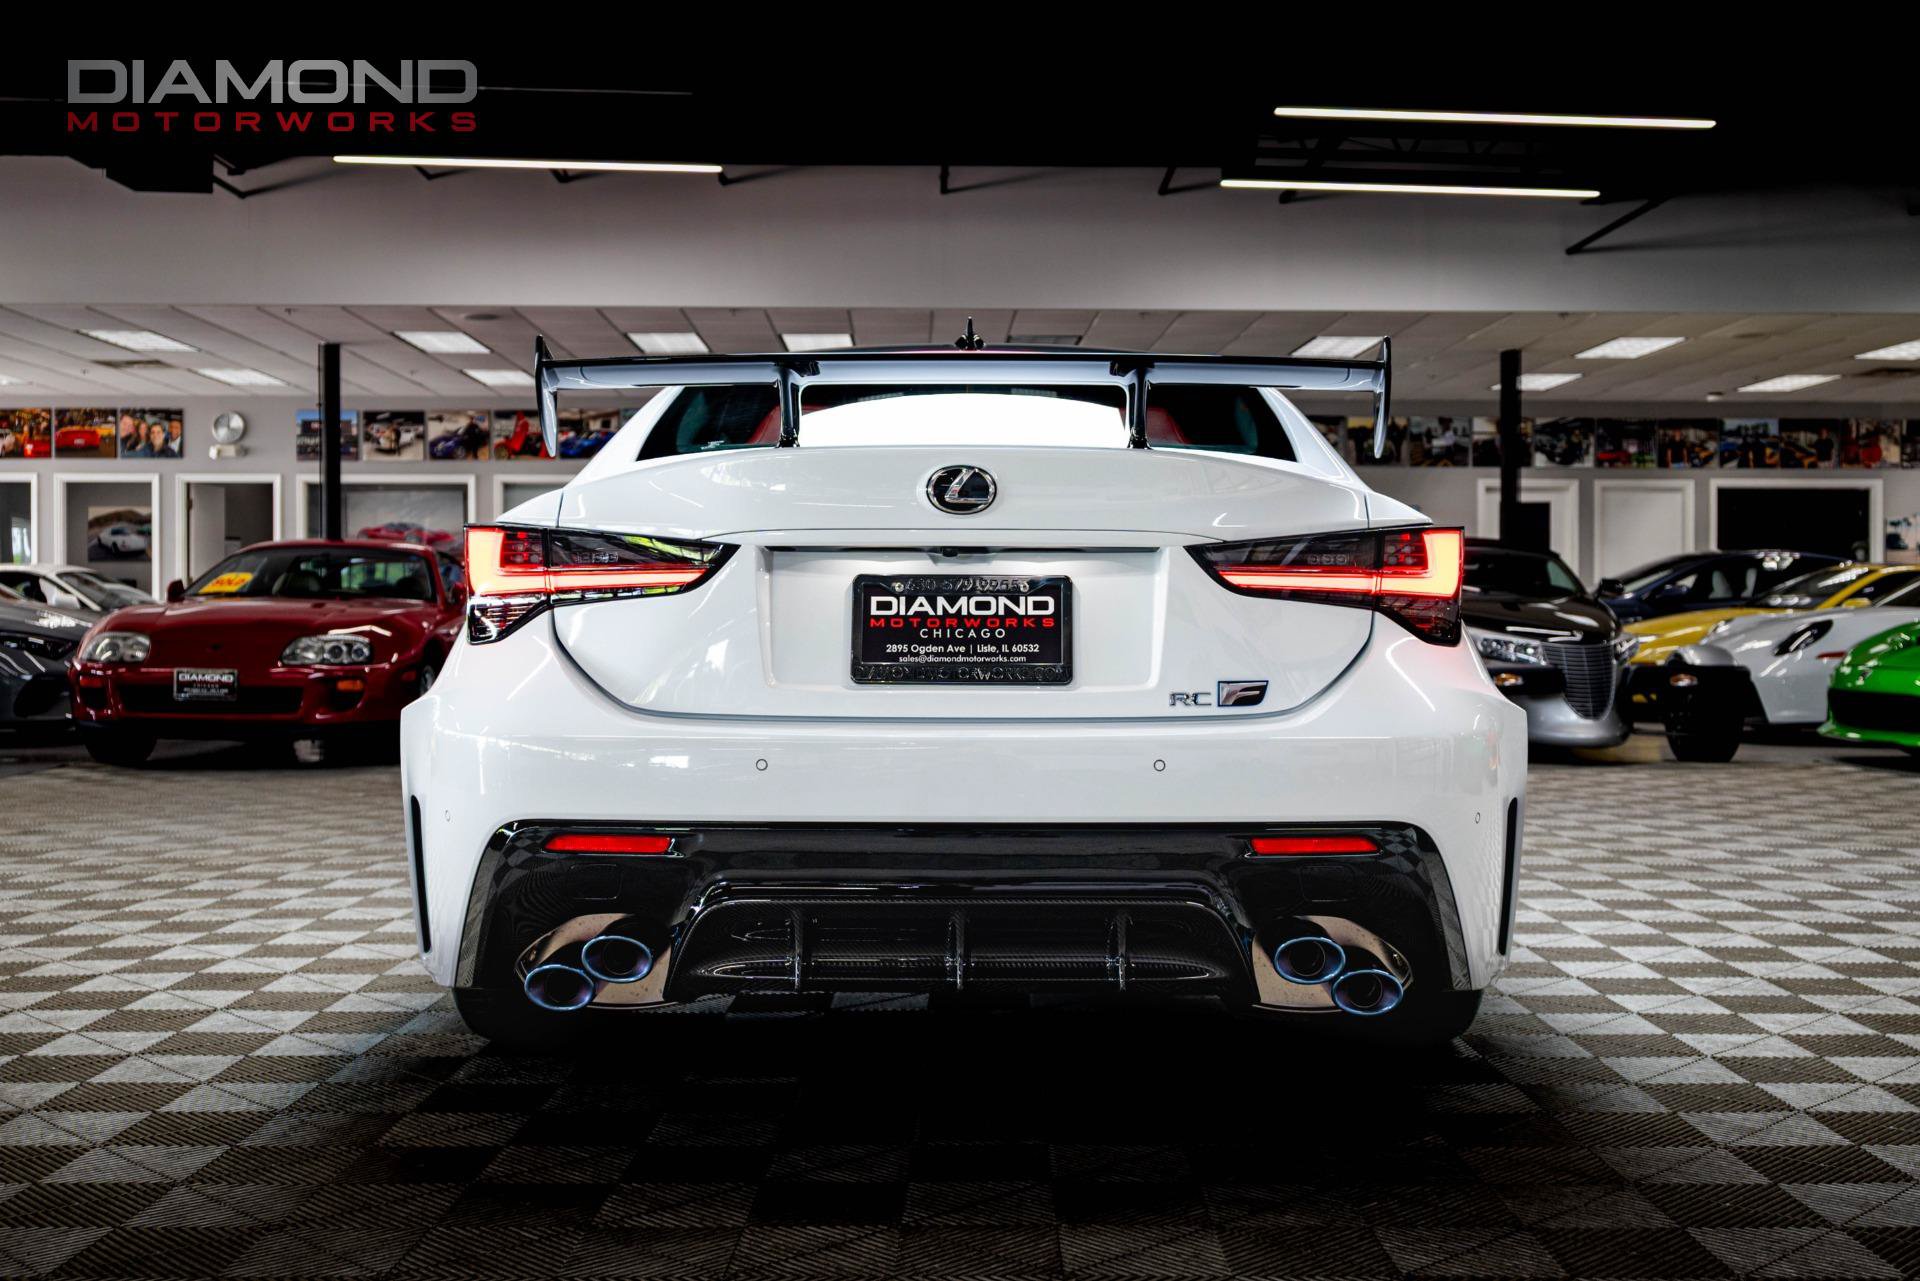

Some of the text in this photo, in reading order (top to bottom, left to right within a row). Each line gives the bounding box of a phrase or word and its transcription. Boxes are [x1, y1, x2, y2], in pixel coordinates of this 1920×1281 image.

[870, 596, 1055, 616] DIAMOND
[870, 617, 1055, 628] MOTORWORKS
[919, 628, 1006, 639] CHICAGO
[885, 643, 909, 653] 2895
[910, 643, 945, 656] Ogden
[946, 643, 966, 653] Ave
[976, 643, 999, 654] Lisle,
[1001, 643, 1010, 653] IL
[1011, 643, 1040, 653] 60532
[899, 654, 1027, 663] sales@diamondmotorworks.com
[178, 673, 234, 683] DIAMOND
[1169, 692, 1213, 706] RC
